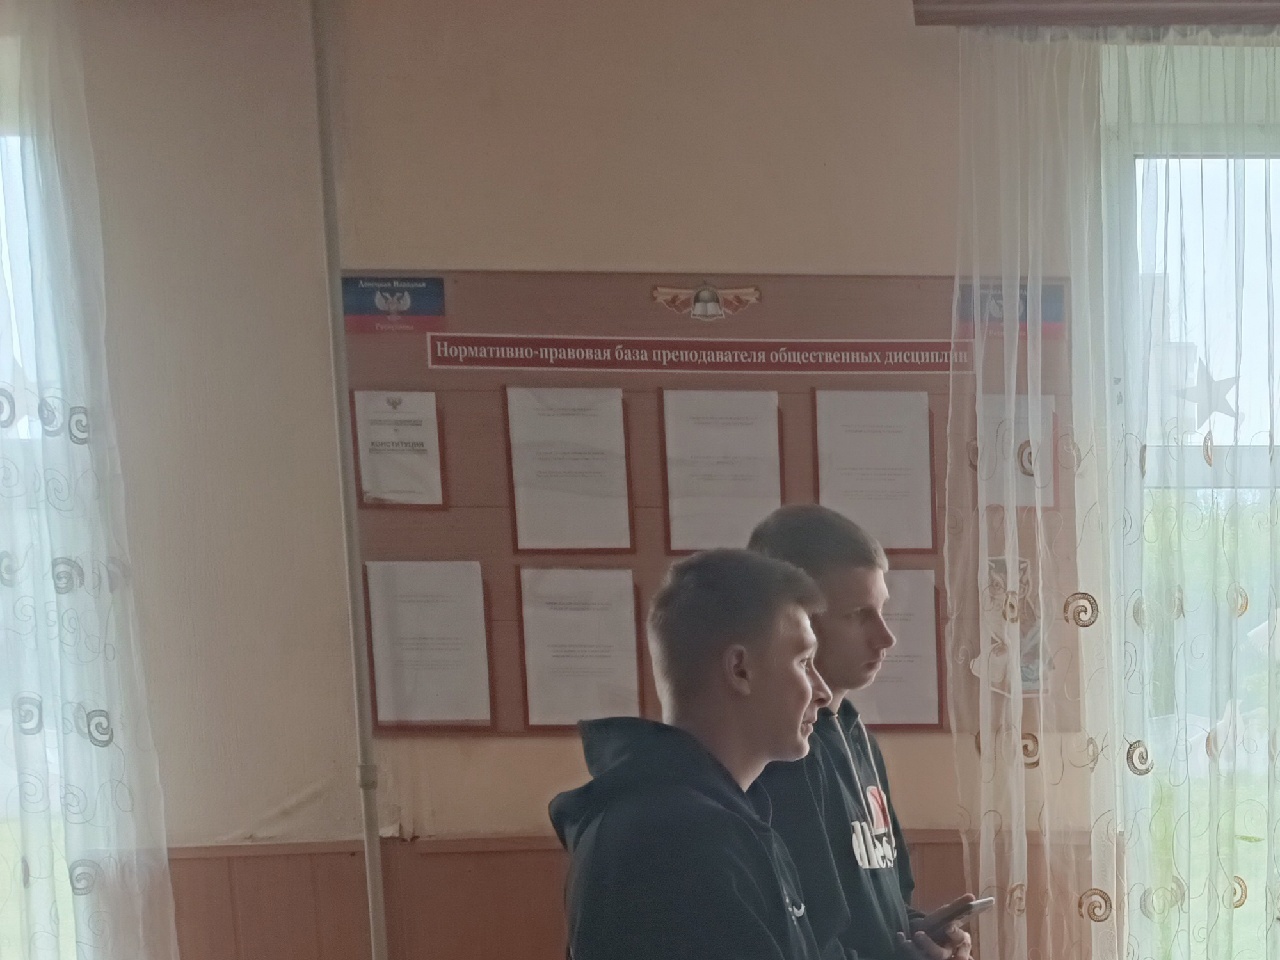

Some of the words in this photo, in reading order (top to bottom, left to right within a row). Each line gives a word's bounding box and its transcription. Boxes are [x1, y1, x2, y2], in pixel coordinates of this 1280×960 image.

[436, 341, 611, 363] Нормативно-правовая
[615, 346, 648, 361] база
[652, 349, 765, 367] преподавателя
[769, 348, 882, 367] общественных
[884, 352, 969, 368] дисциплин
